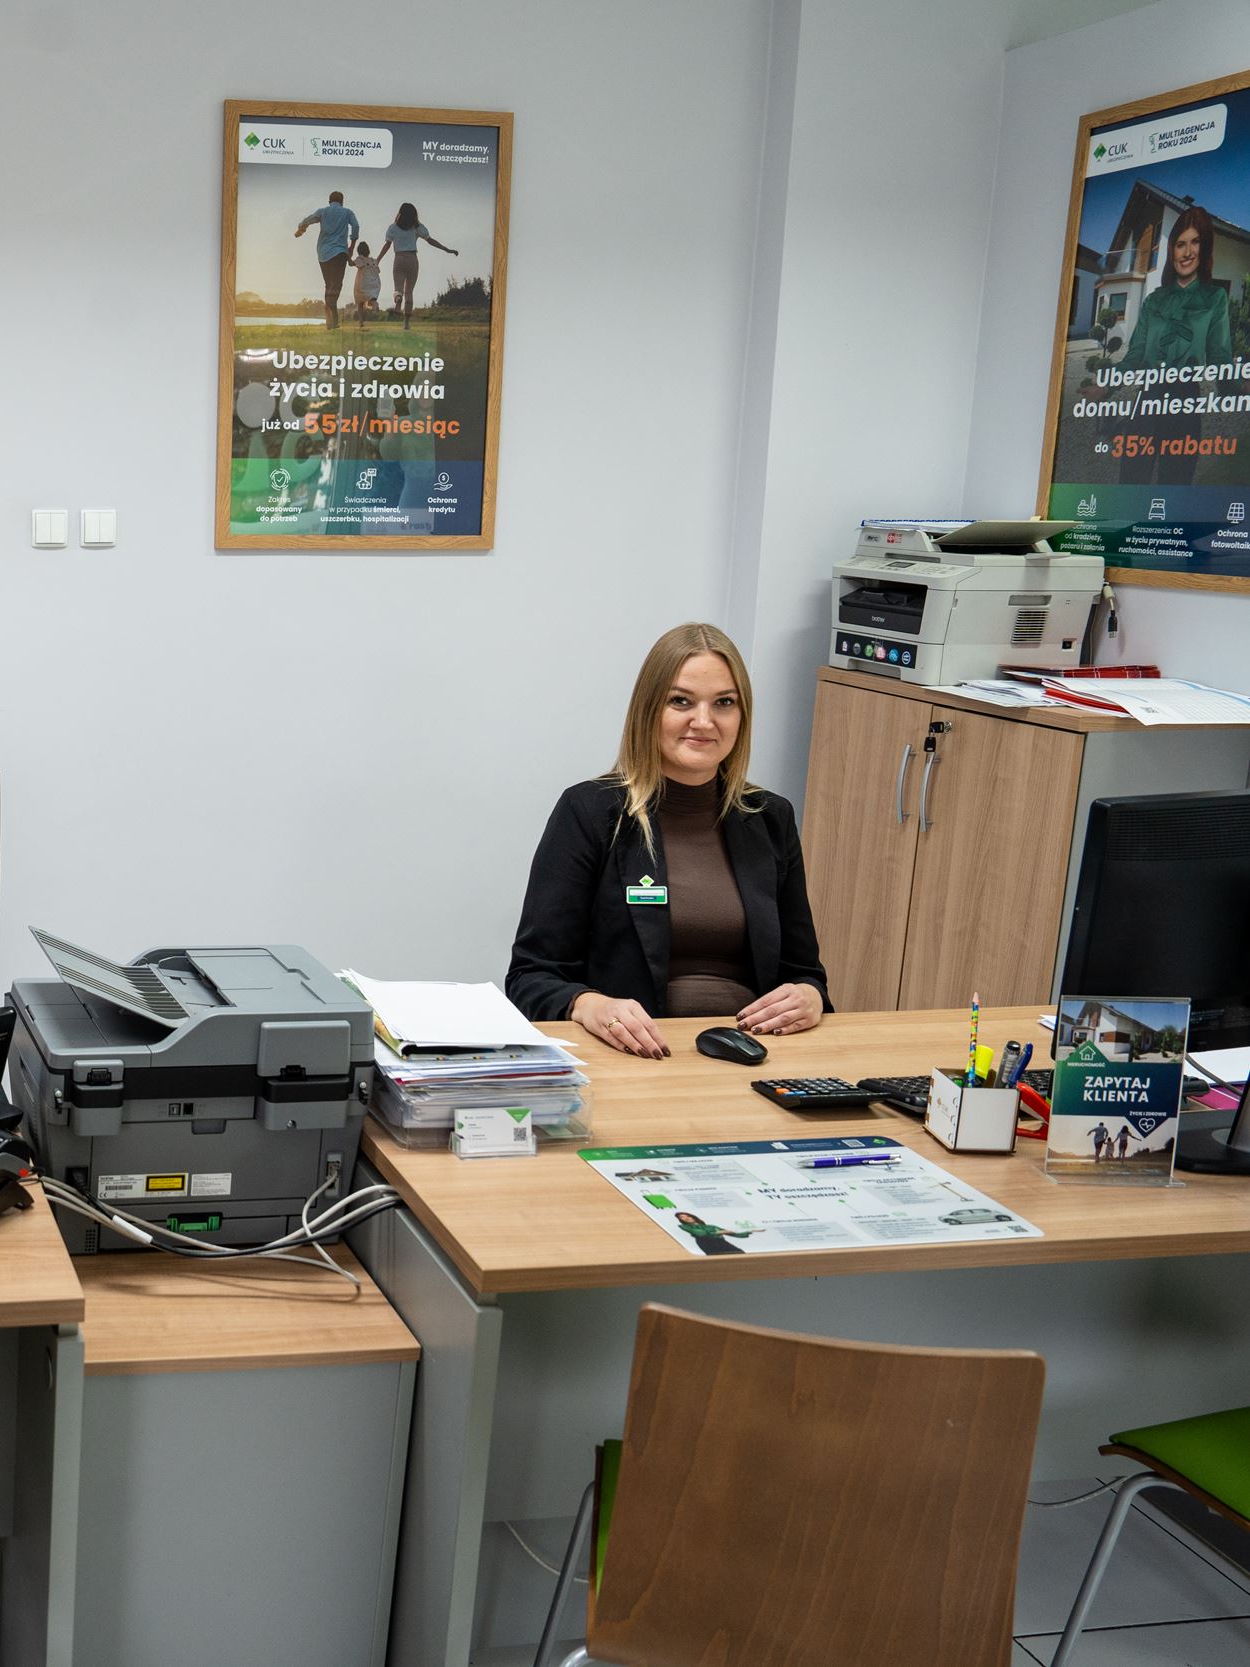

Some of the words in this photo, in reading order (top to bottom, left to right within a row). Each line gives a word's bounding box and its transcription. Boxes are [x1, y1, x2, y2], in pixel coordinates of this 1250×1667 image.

[1158, 121, 1215, 141] MULTIAGENCJA
[263, 138, 286, 149] CUK
[321, 140, 382, 149] MULTIAGENCJA
[422, 141, 438, 150] MY
[439, 143, 489, 154] doradzamy,
[1157, 138, 1178, 150] ROKU
[1179, 134, 1198, 146] 2024
[322, 148, 344, 156] ROKU
[1108, 142, 1128, 157] CUK
[422, 152, 435, 161] TY
[272, 350, 445, 376] Ubezpieczenie
[1096, 356, 1250, 391] Ubezpieczenie
[269, 378, 332, 403] życia
[339, 378, 345, 398] i
[351, 380, 445, 399] zdrowia
[261, 418, 280, 433] już
[283, 419, 300, 430] od
[1094, 442, 1109, 453] do
[1111, 435, 1155, 458] 35%
[1160, 434, 1238, 456] rabatu
[344, 496, 387, 504] Świadczenia
[256, 505, 303, 514] dopasowany
[428, 506, 456, 514] kredytu
[270, 515, 298, 523] potrzeb
[1217, 529, 1248, 538] Ochrona
[1084, 1076, 1151, 1089] ZAPYTAJ
[1083, 1090, 1149, 1103] KLIENTA
